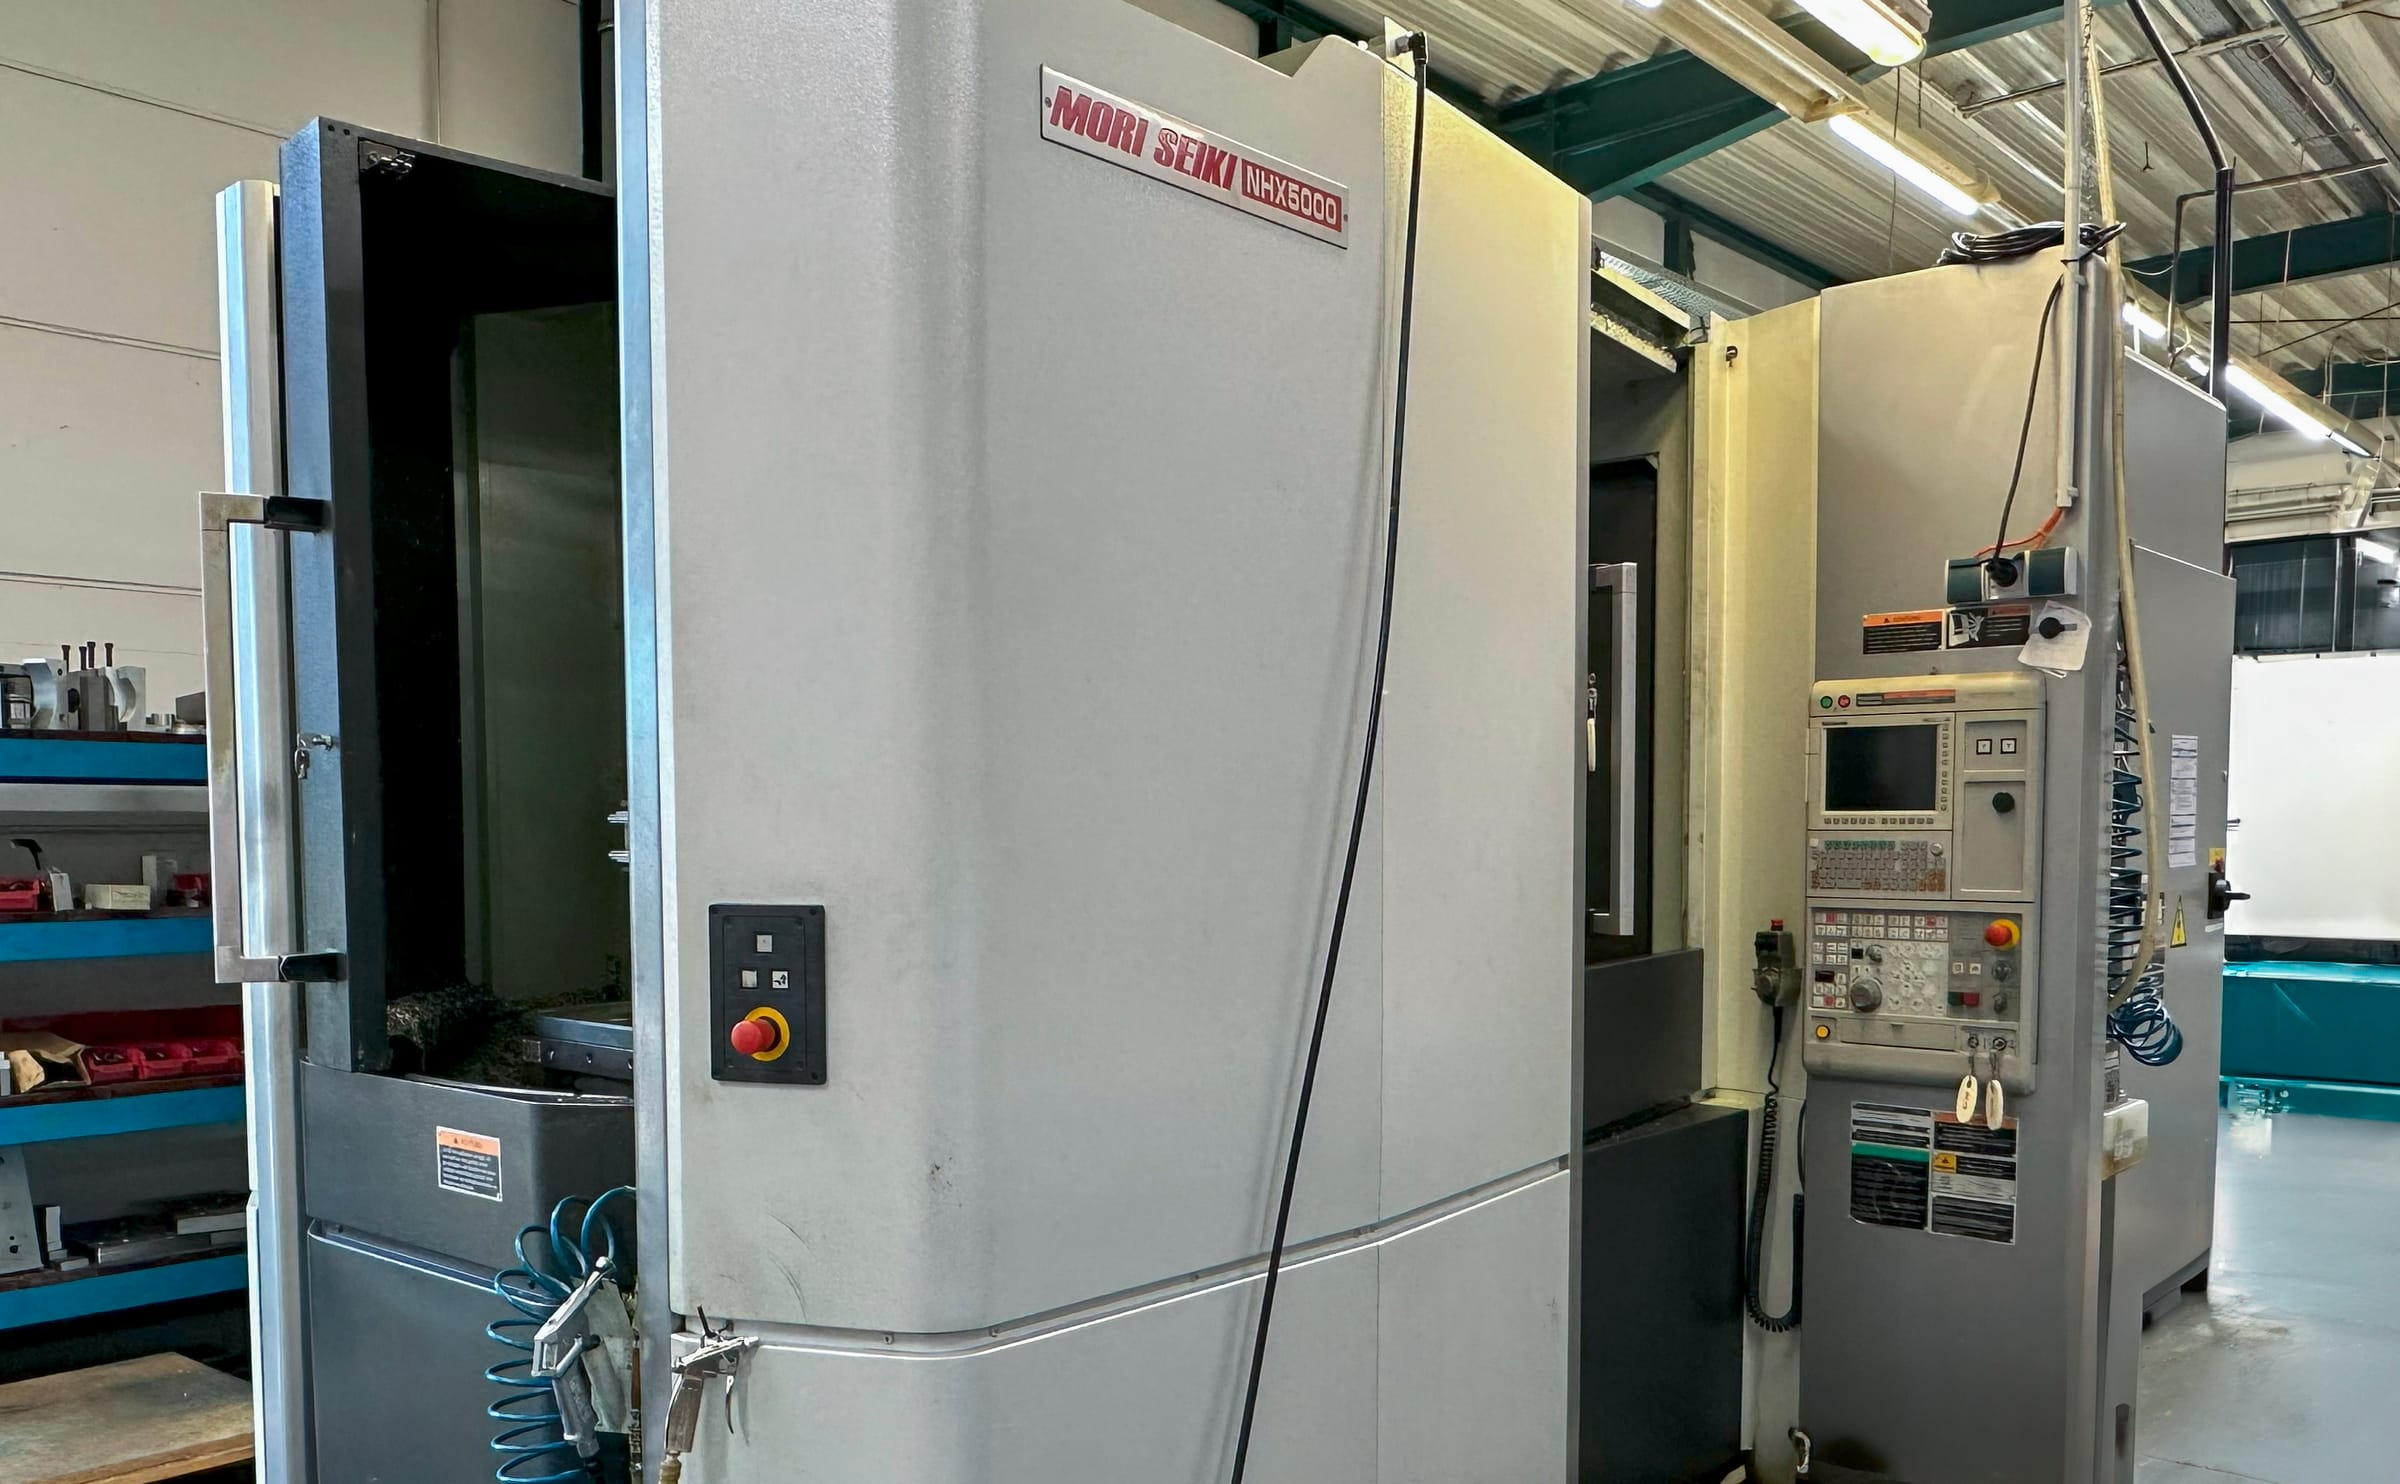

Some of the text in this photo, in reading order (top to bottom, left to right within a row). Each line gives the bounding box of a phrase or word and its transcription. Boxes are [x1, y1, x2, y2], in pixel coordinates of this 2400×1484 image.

[1050, 85, 1337, 225] MORI SEIKI NHX5000
